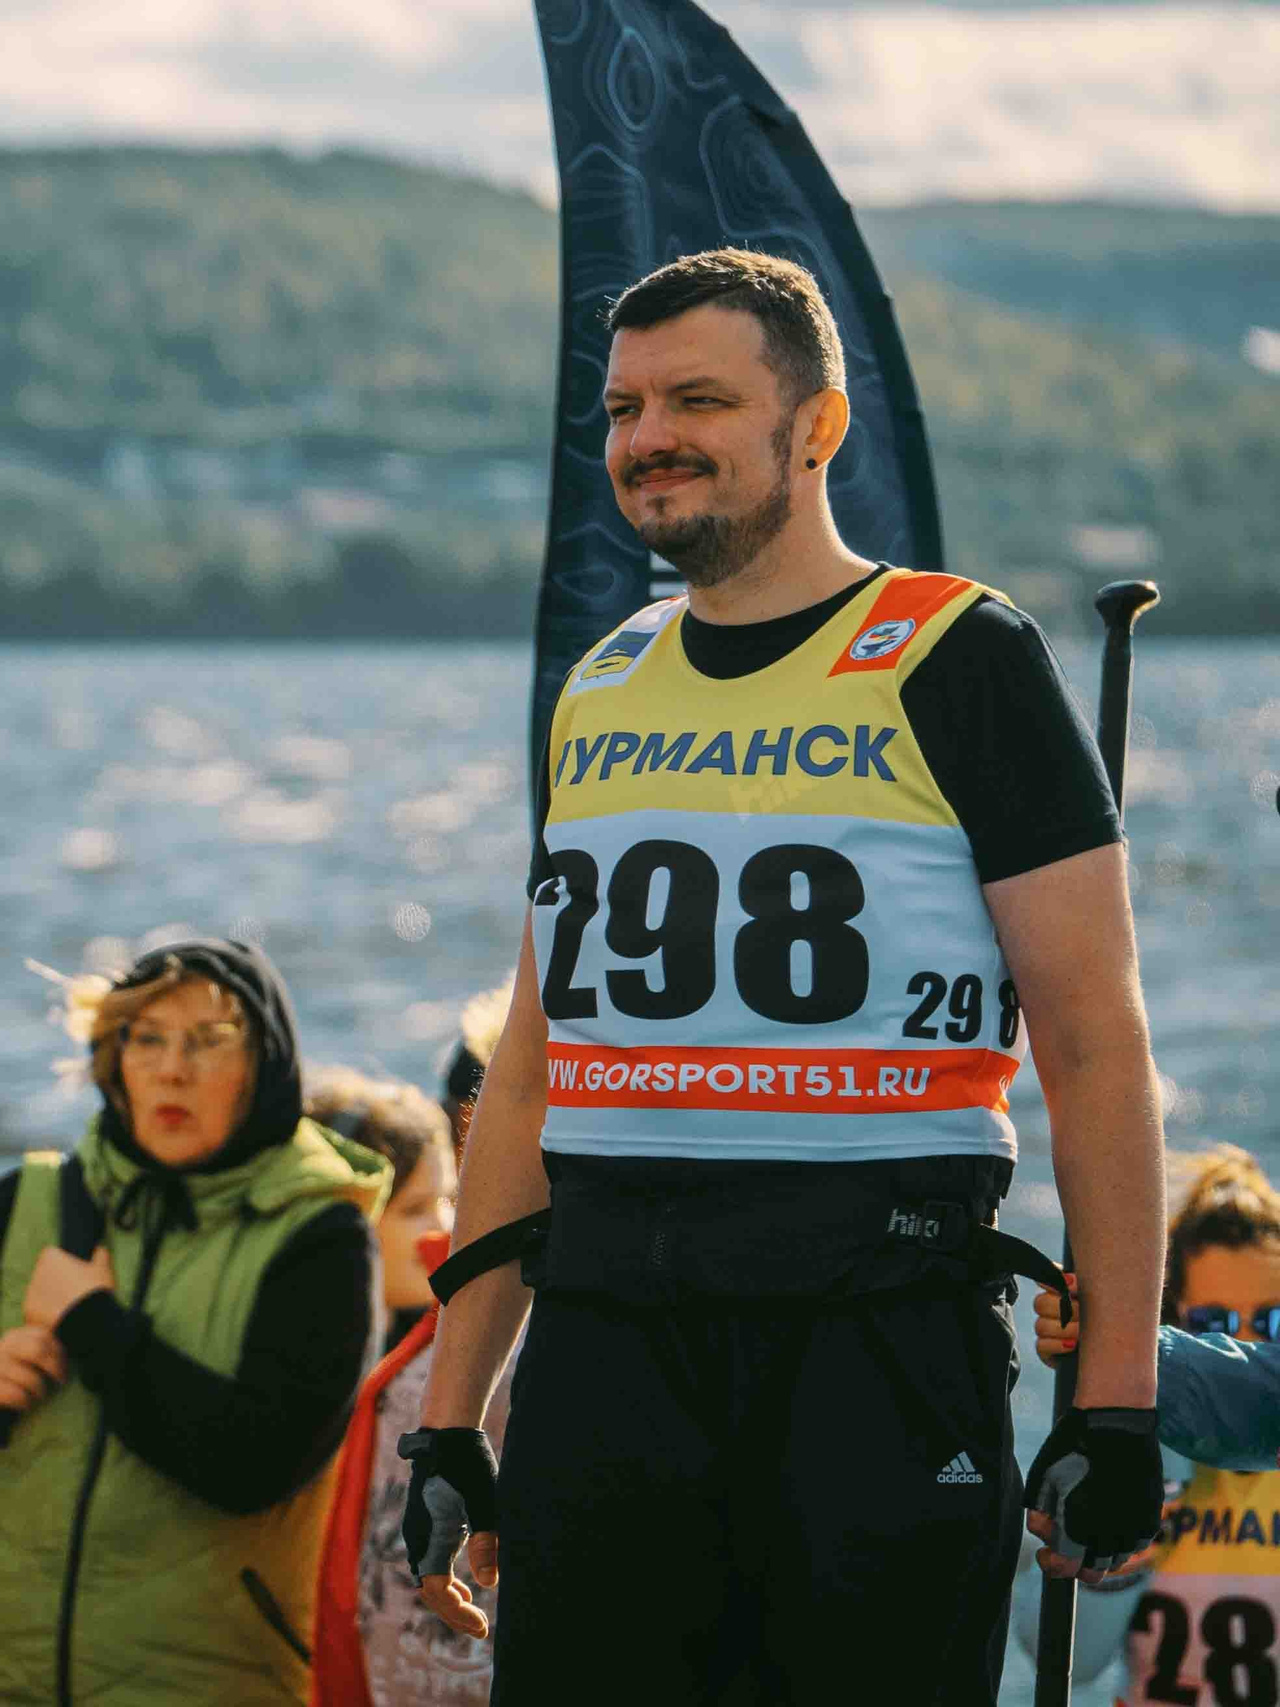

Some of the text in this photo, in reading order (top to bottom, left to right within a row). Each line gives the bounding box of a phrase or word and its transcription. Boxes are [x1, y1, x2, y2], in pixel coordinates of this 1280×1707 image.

[534, 839, 869, 1025] 298
[936, 1471, 984, 1484] adidas
[1157, 1506, 1280, 1546] РМА
